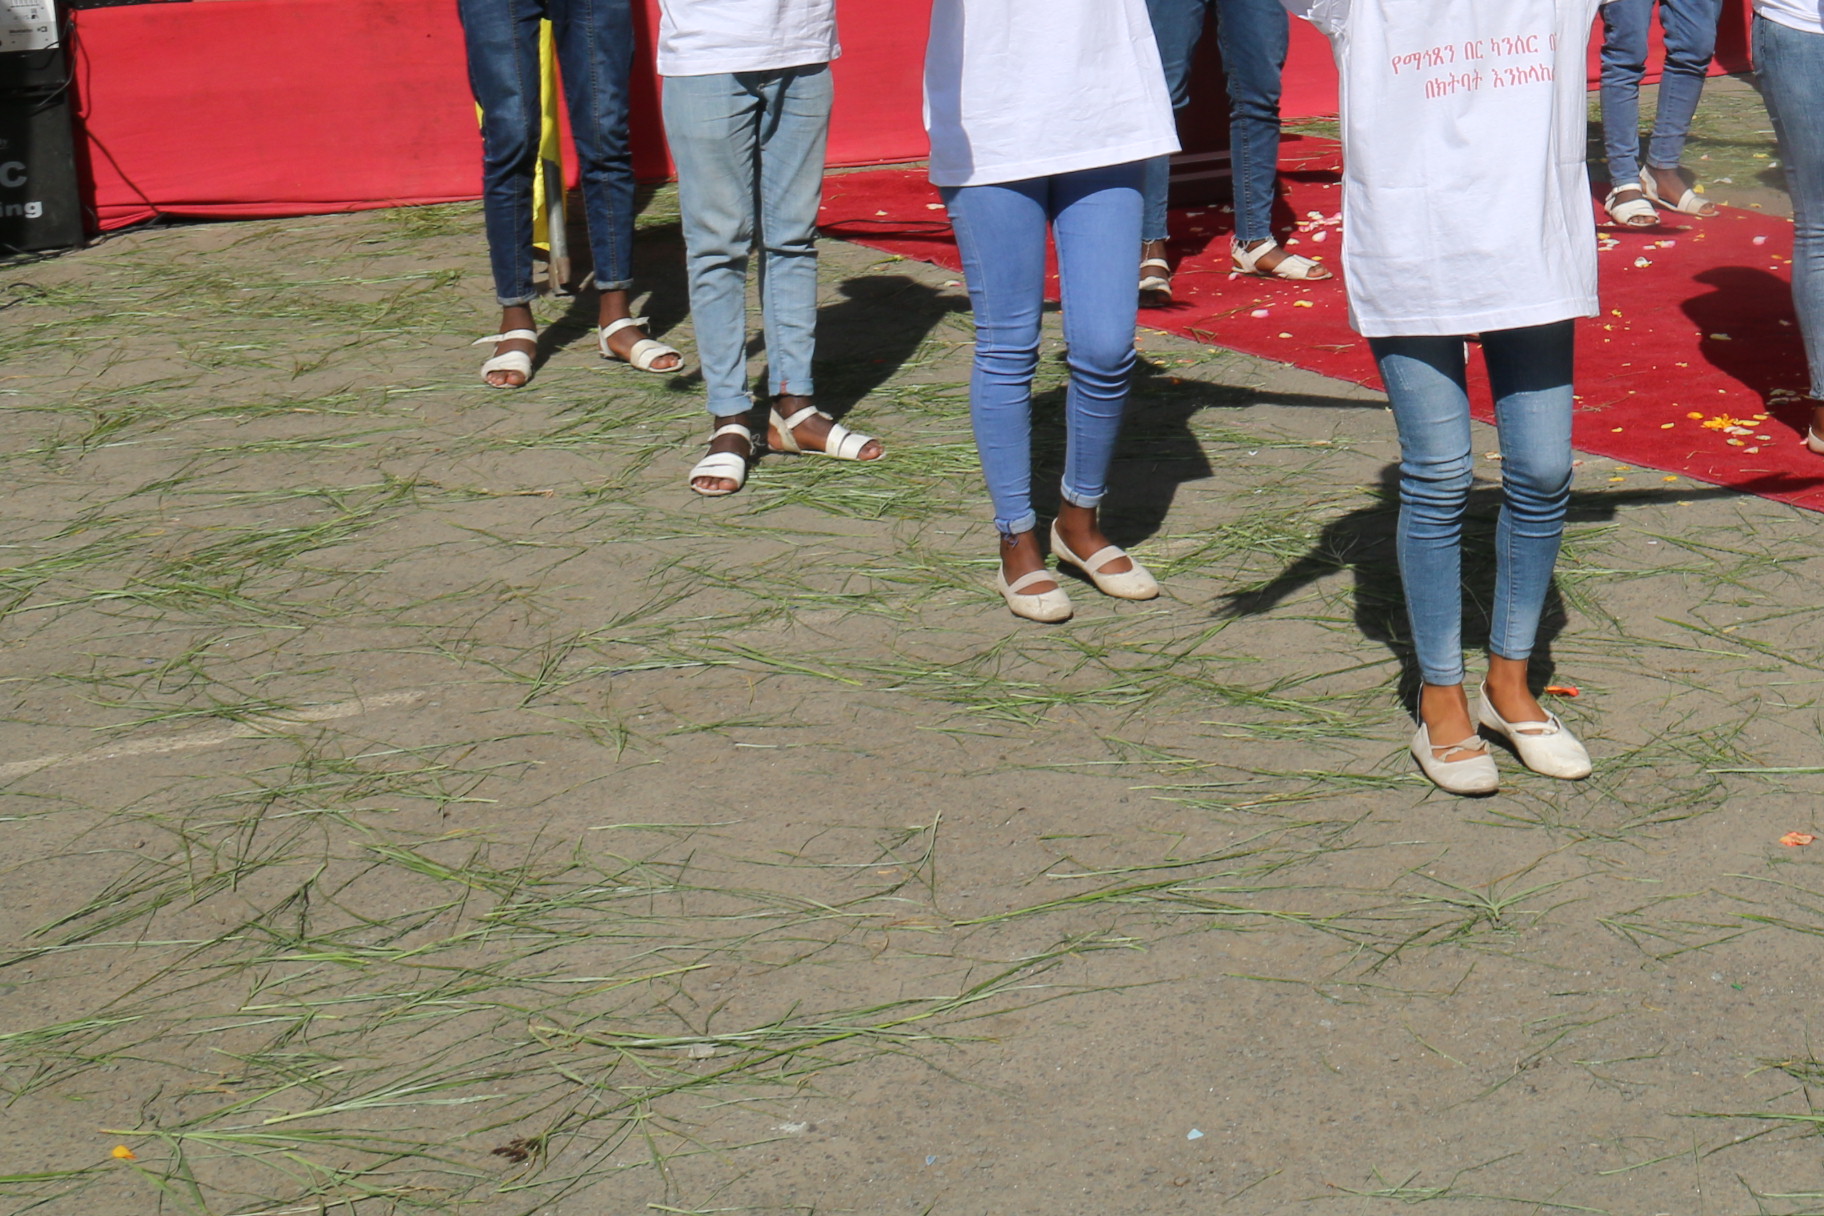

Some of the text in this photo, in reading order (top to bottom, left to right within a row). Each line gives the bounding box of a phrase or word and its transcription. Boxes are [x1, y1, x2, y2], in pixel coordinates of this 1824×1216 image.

[1391, 44, 1455, 75] የማኅጸን
[1464, 40, 1484, 60] በር
[1425, 68, 1483, 100] በክትባት
